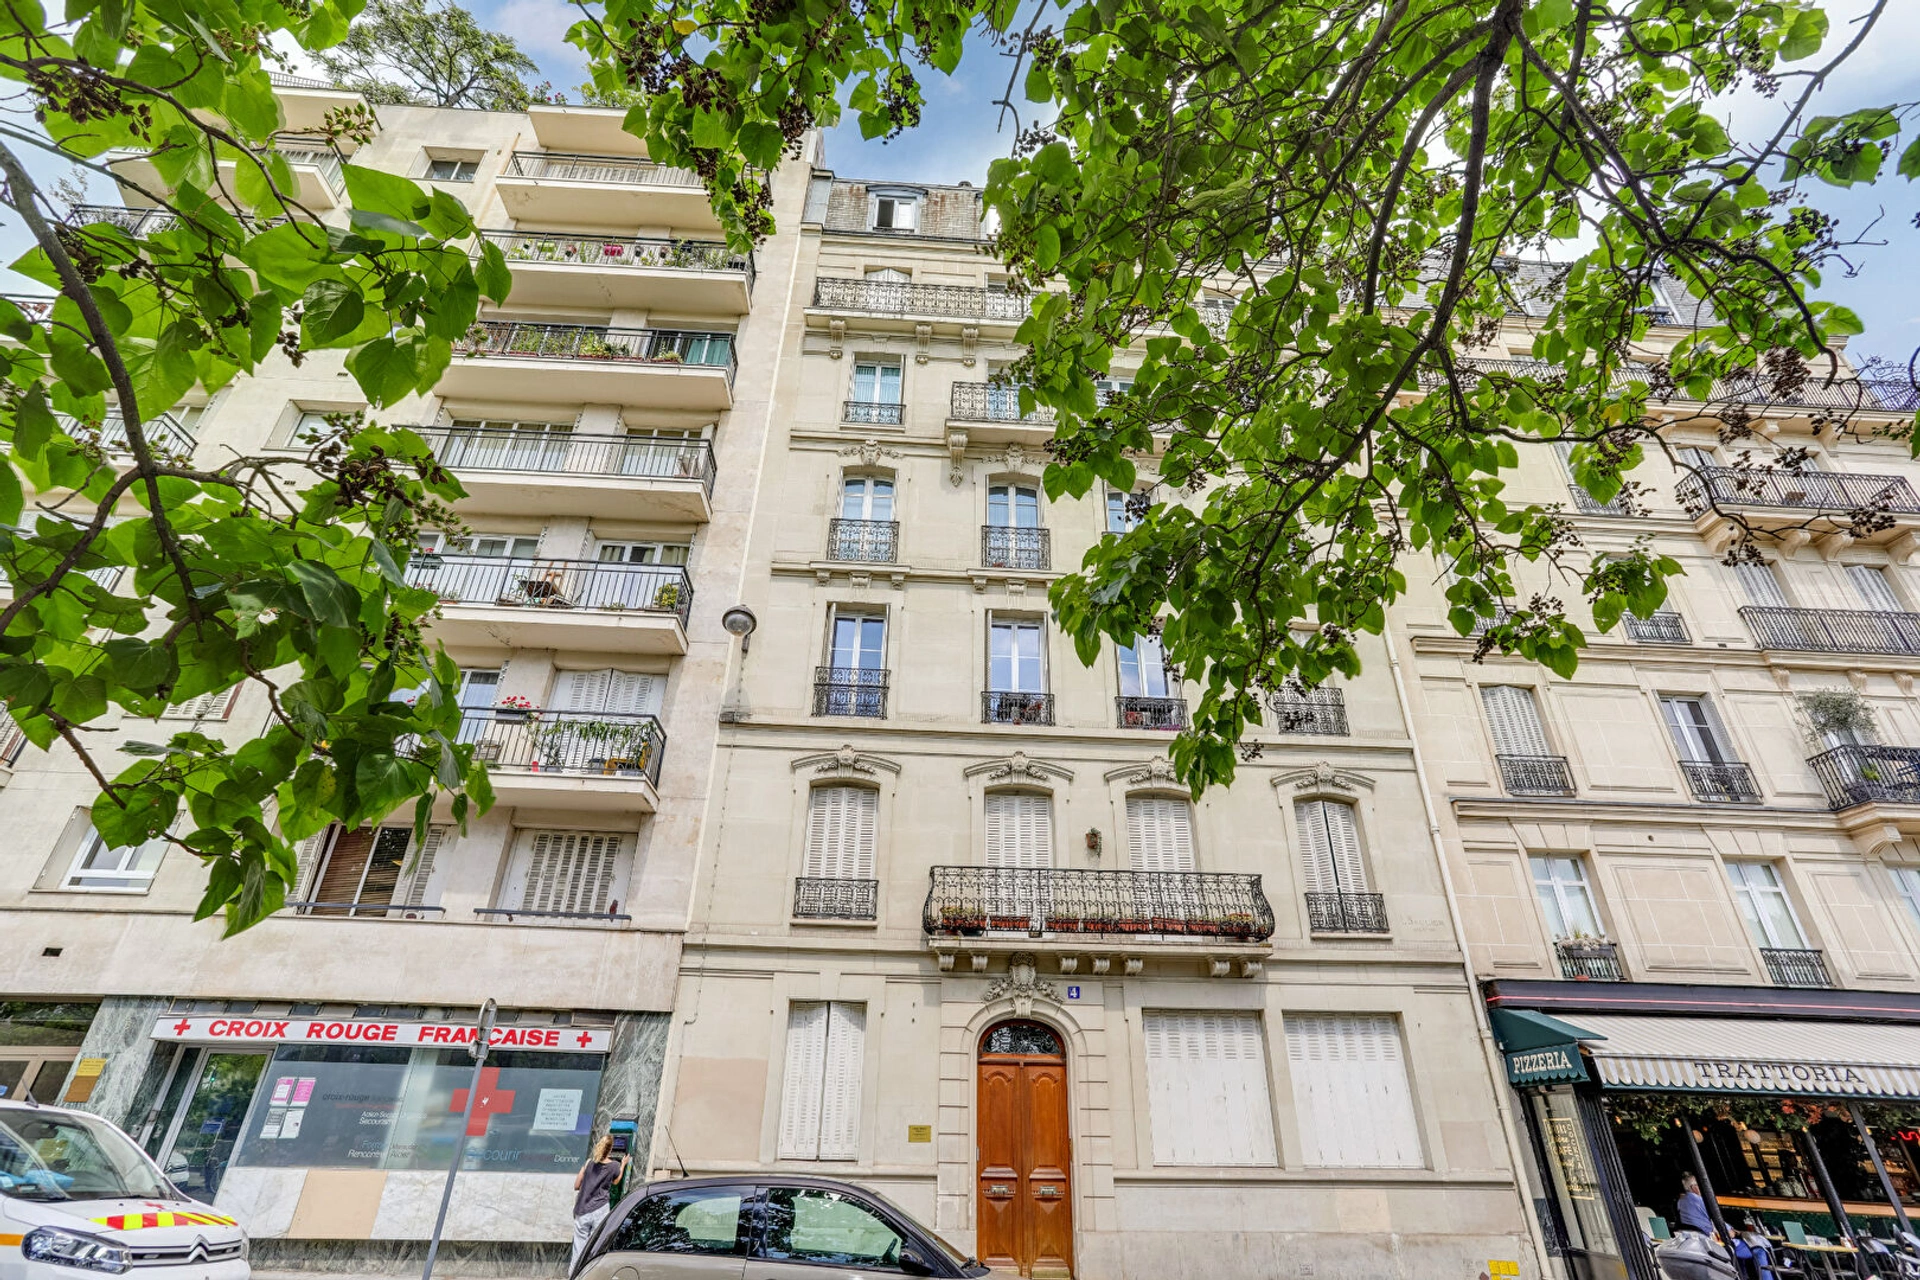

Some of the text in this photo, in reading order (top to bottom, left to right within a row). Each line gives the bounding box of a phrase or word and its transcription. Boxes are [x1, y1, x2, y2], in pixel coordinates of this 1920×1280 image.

[1070, 987, 1077, 998] 4
[208, 1019, 290, 1038] CROIX
[306, 1022, 399, 1041] ROUGE
[1512, 1050, 1573, 1074] PIZZERIA
[1694, 1062, 1865, 1083] TRATTORIA
